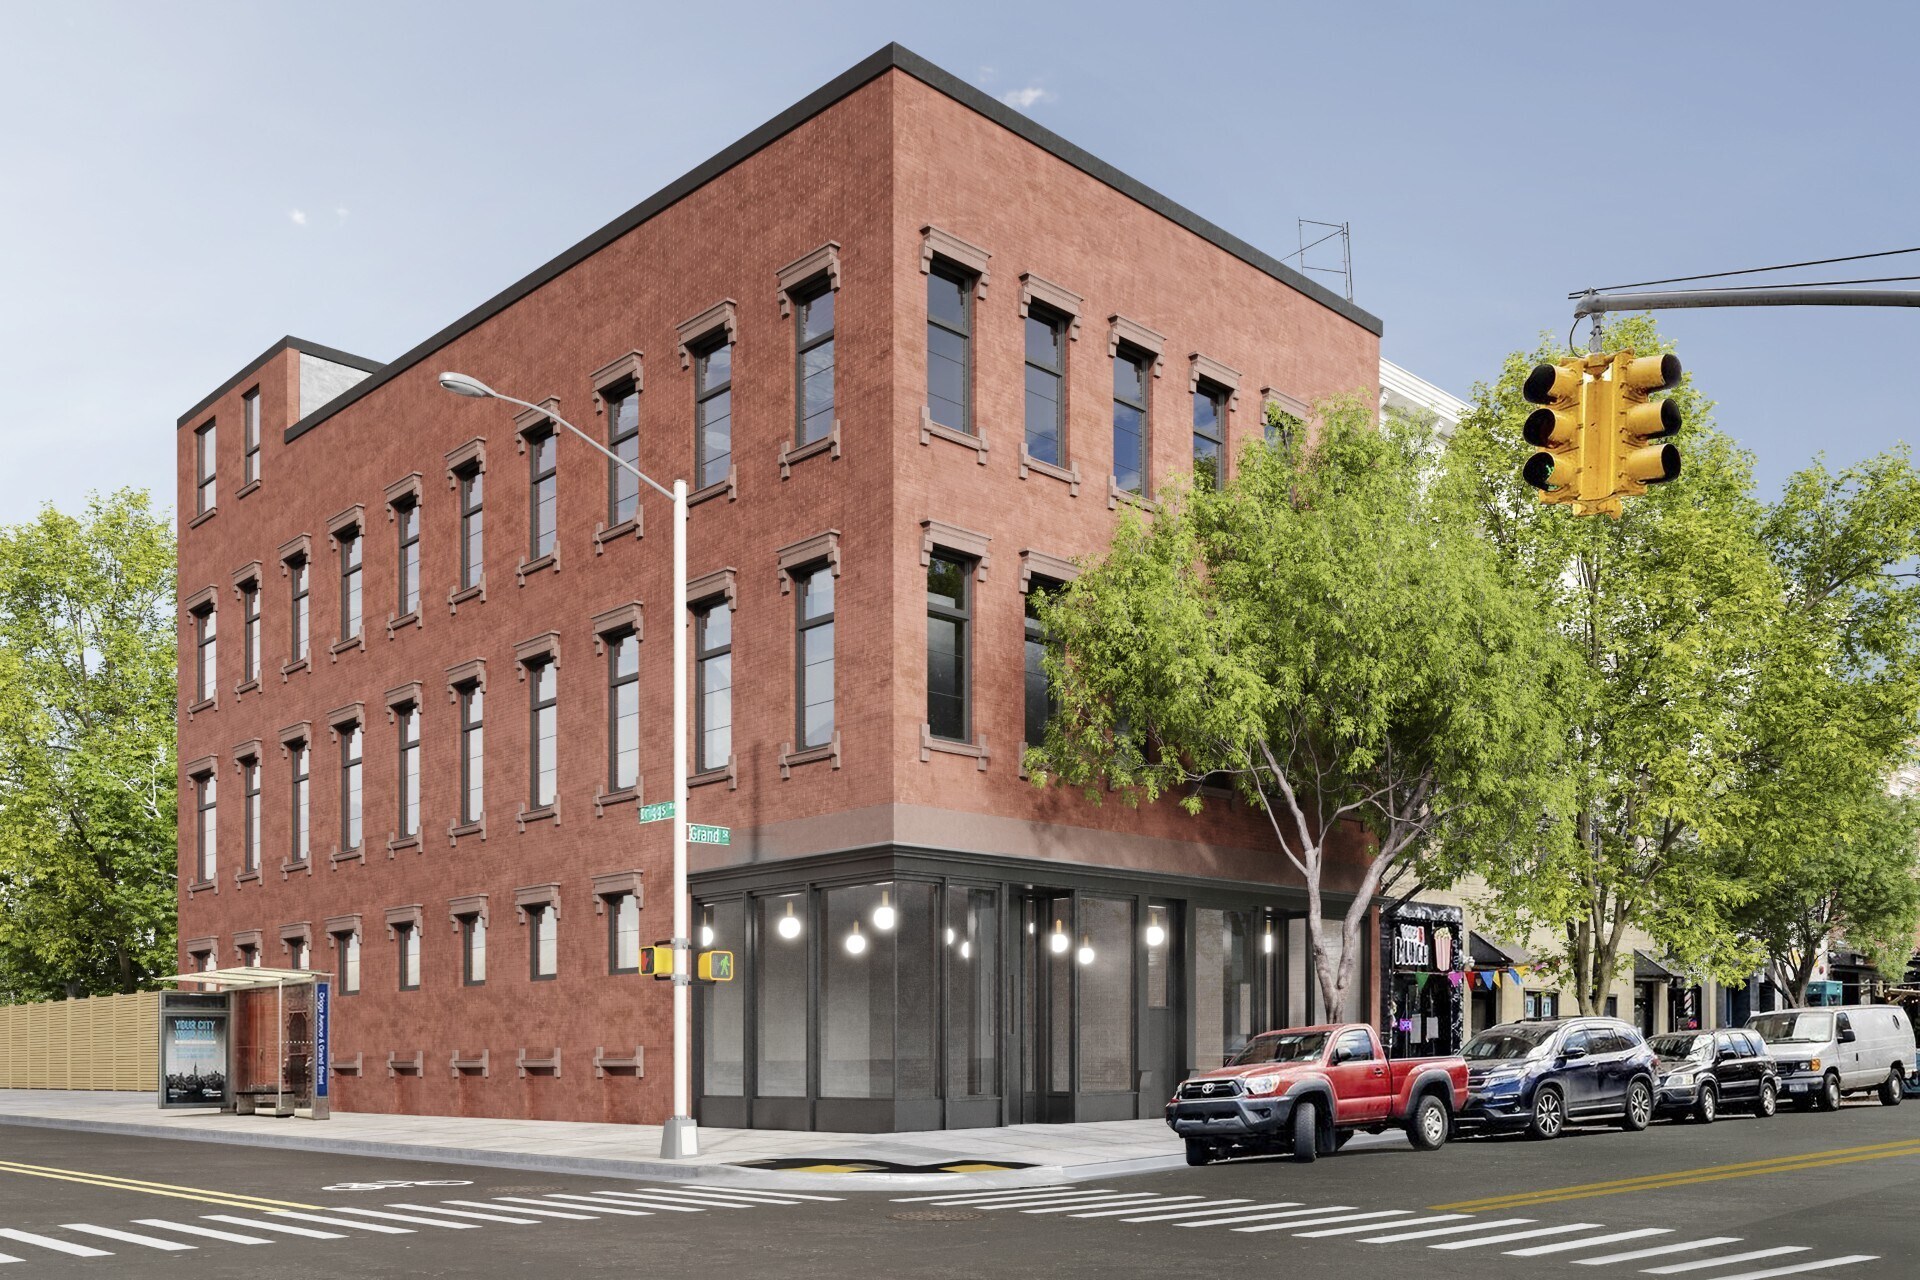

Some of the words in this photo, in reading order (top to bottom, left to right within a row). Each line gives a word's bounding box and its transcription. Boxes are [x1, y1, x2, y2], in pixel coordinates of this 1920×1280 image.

[640, 805, 666, 820] Driggs
[690, 826, 719, 843] Grand
[317, 992, 326, 1013] Driggs
[174, 1020, 197, 1030] YOUR
[197, 1020, 216, 1030] CITY
[317, 1014, 326, 1038] Avenue
[318, 1045, 326, 1065] Grand
[318, 1066, 326, 1085] Street
